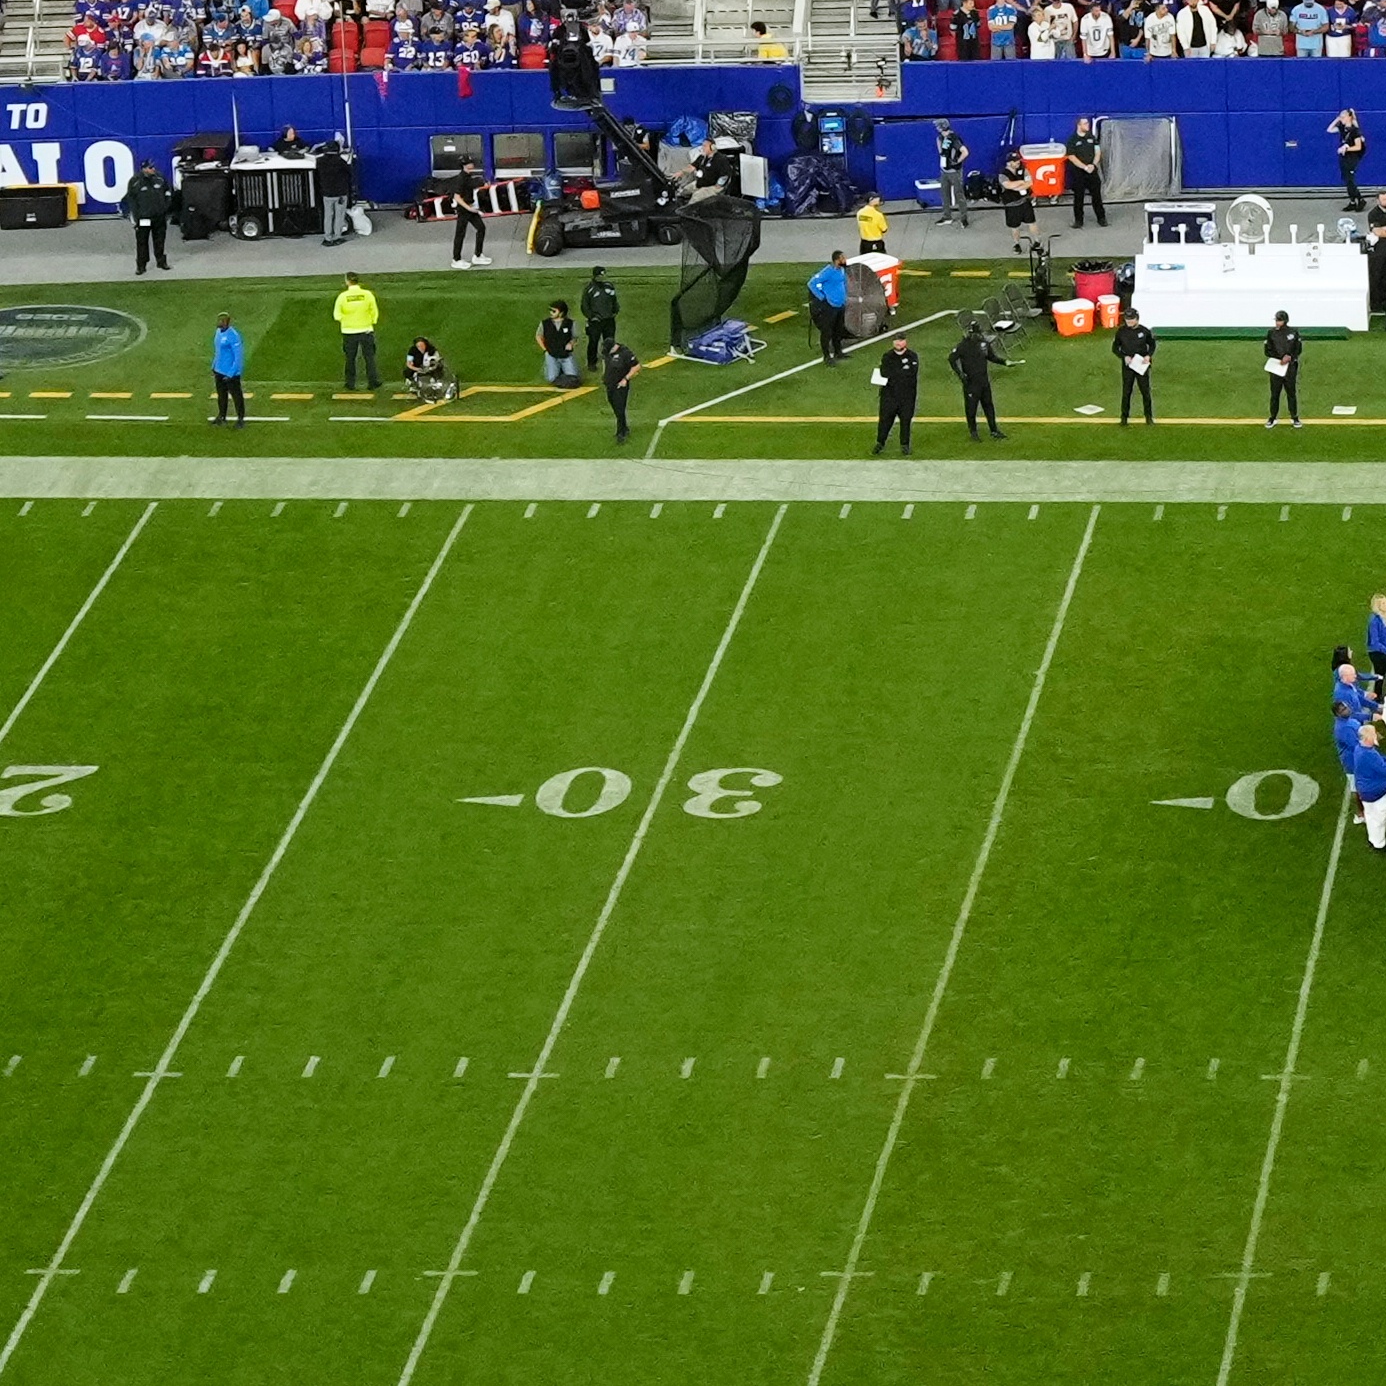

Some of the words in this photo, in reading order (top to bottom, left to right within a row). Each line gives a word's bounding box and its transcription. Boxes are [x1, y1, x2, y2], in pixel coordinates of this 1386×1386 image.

[6, 102, 49, 130] TO
[1072, 314, 1083, 327] G
[534, 766, 785, 820] 30
[1225, 769, 1321, 821] 0
